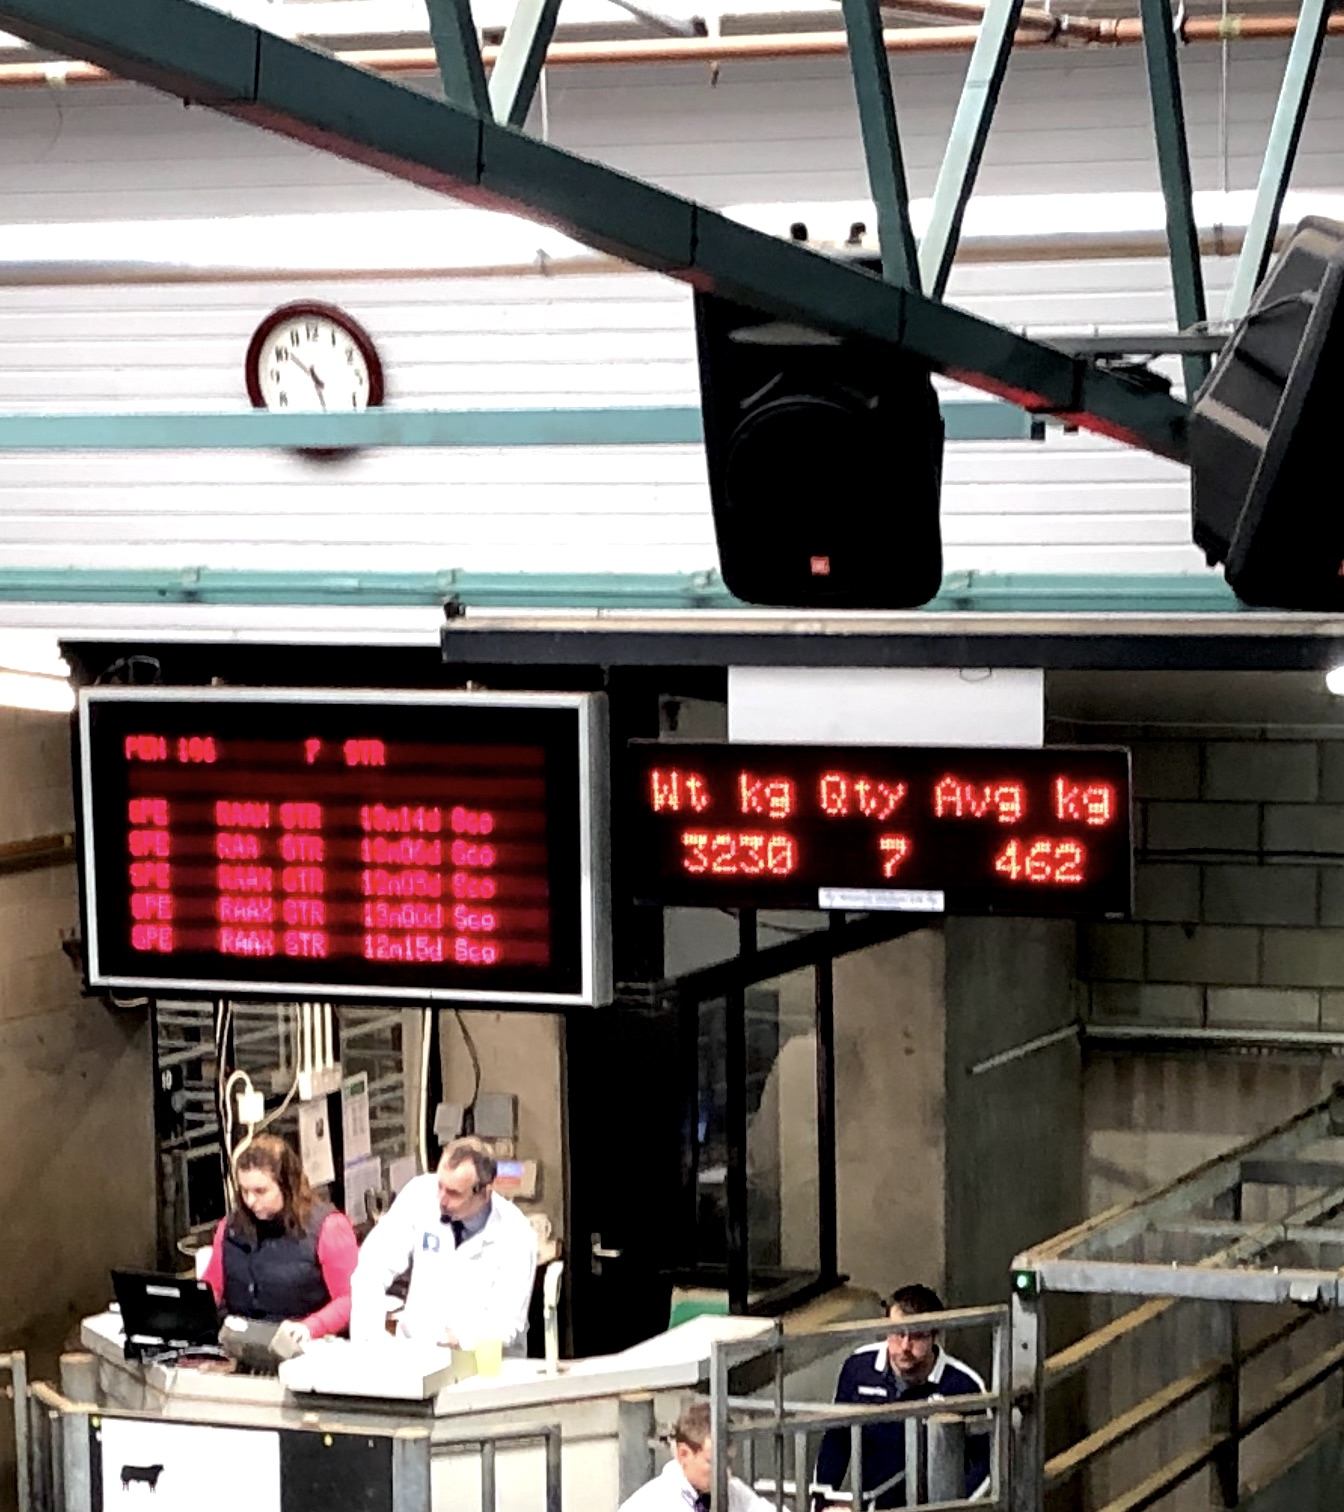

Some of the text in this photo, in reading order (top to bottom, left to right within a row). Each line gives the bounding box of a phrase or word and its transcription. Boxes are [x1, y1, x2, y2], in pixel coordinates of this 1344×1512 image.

[290, 329, 299, 347] 11
[305, 321, 319, 342] 12
[651, 770, 1113, 825] Wt kg Qty Avg kg
[682, 831, 1083, 883] 3230 7 462
[283, 898, 325, 925] STR
[453, 904, 495, 931] Sco
[285, 930, 327, 957] STR
[454, 937, 496, 964] Sco
